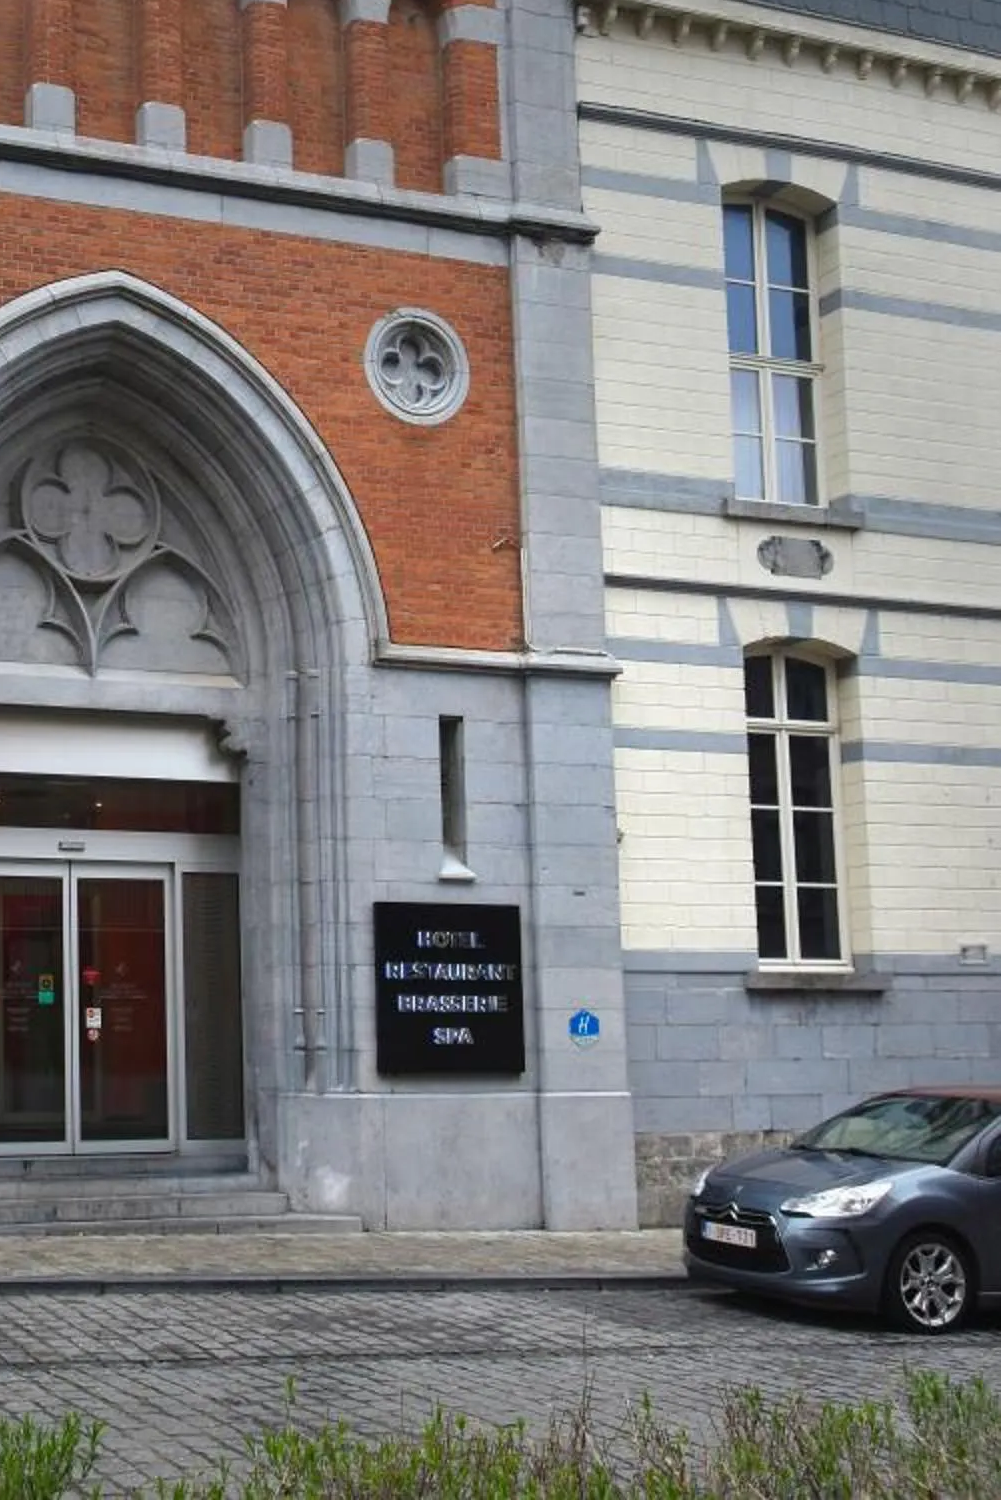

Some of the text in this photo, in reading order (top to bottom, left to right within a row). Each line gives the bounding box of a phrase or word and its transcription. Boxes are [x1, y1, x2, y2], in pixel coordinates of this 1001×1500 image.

[417, 931, 486, 949] HOTEL
[386, 961, 517, 980] RESTAURANT
[398, 995, 509, 1012] BRASSERIE
[433, 1027, 474, 1044] SPA
